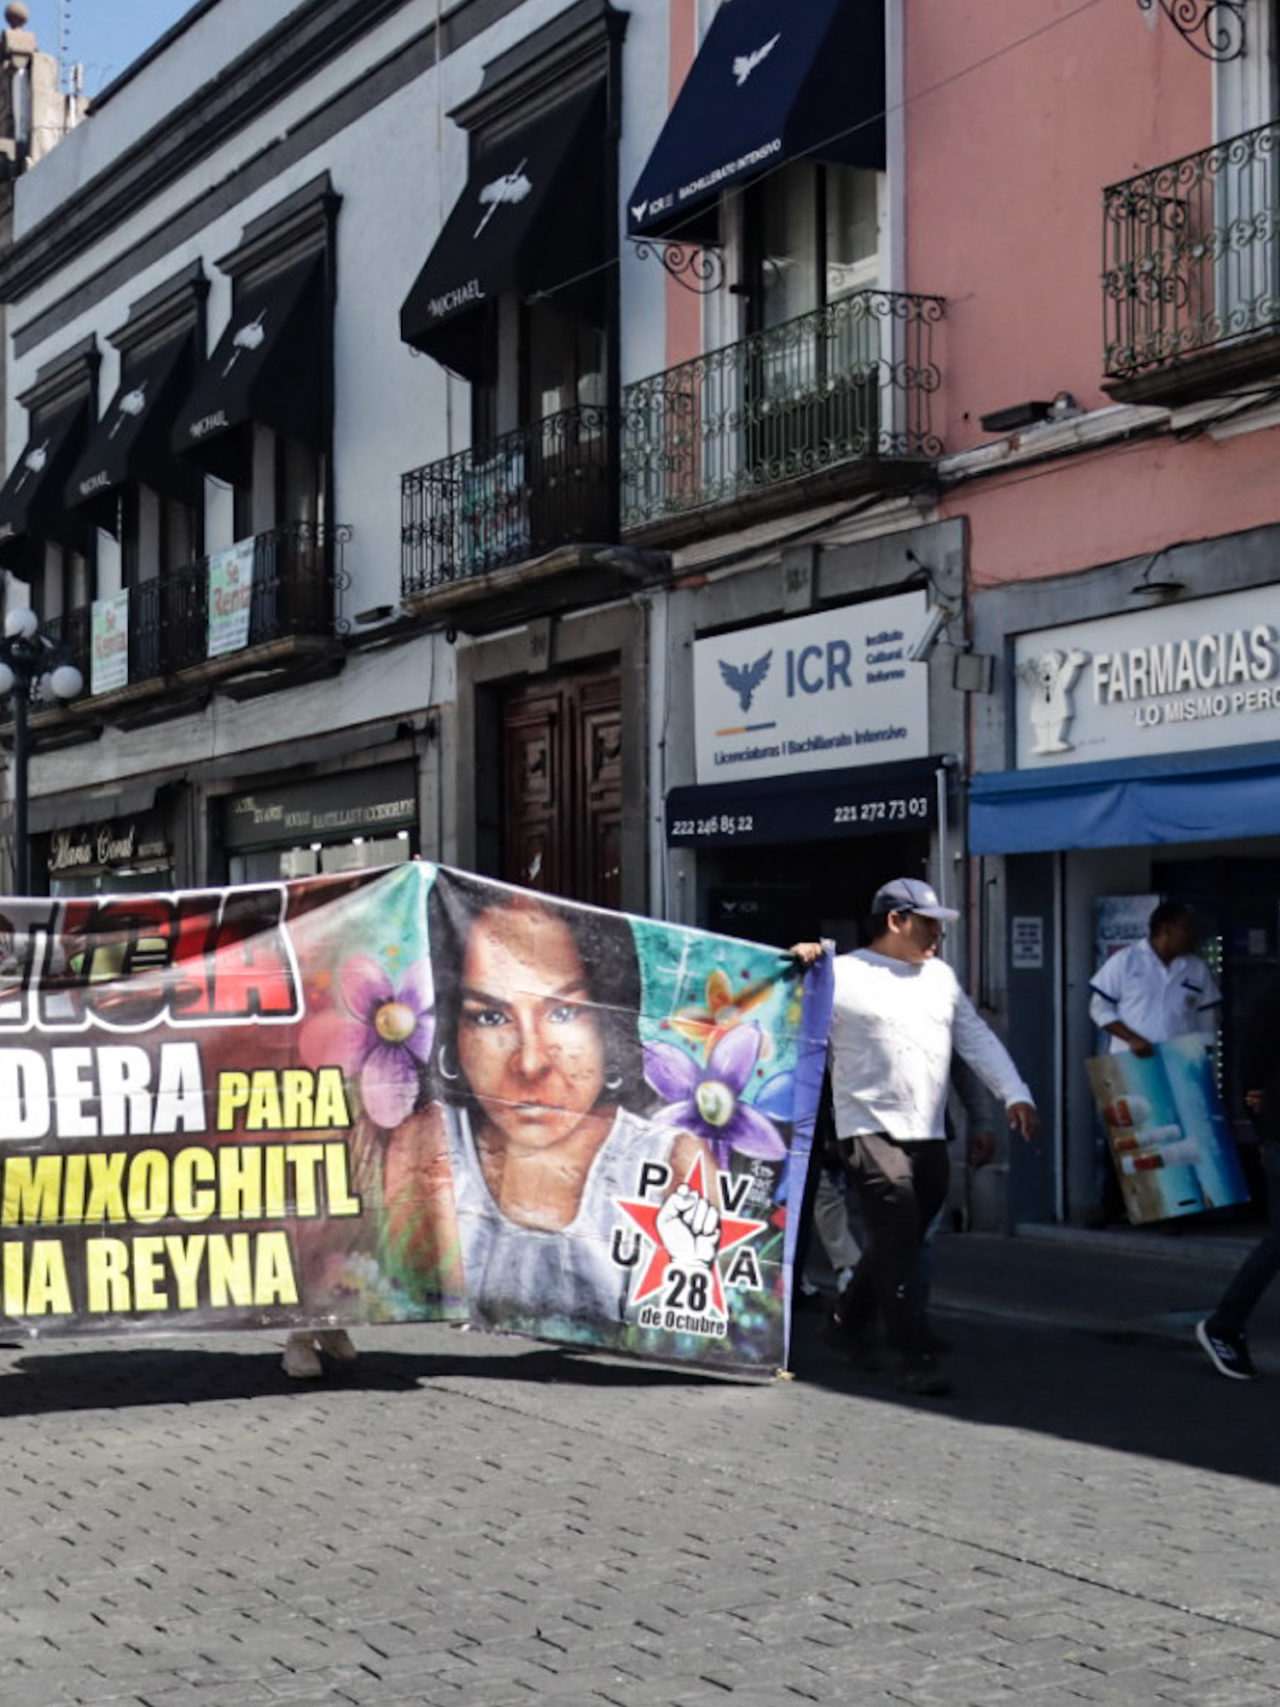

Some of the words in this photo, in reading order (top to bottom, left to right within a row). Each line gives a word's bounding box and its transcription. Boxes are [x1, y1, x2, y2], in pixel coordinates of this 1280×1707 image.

[735, 137, 782, 172] INTENSIVO
[427, 278, 486, 317] MICHAEL
[865, 629, 905, 647] Instituto
[865, 648, 904, 666] Cultural
[785, 639, 853, 698] ICR
[865, 668, 907, 684] Reforma
[1092, 624, 1274, 704] FARMACIAS
[1165, 695, 1229, 722] MISMO
[713, 742, 781, 766] Licenciaturas
[787, 733, 853, 756] Bachillerato
[854, 724, 908, 745] Intensivo
[671, 820, 696, 836] 222
[696, 816, 719, 837] 246
[719, 814, 736, 835] 85
[736, 816, 754, 831] 22
[833, 805, 858, 823] 221
[860, 802, 887, 822] 272
[888, 800, 907, 820] 73
[908, 797, 928, 817] 03
[217, 1067, 350, 1132] PARA
[638, 1162, 668, 1198] P
[720, 1174, 749, 1213] V
[86, 1231, 299, 1314] REYNA
[611, 1229, 642, 1267] U
[728, 1250, 758, 1287] A
[665, 1269, 708, 1312] 28
[641, 1307, 662, 1326] de
[664, 1311, 726, 1336] Octubre
